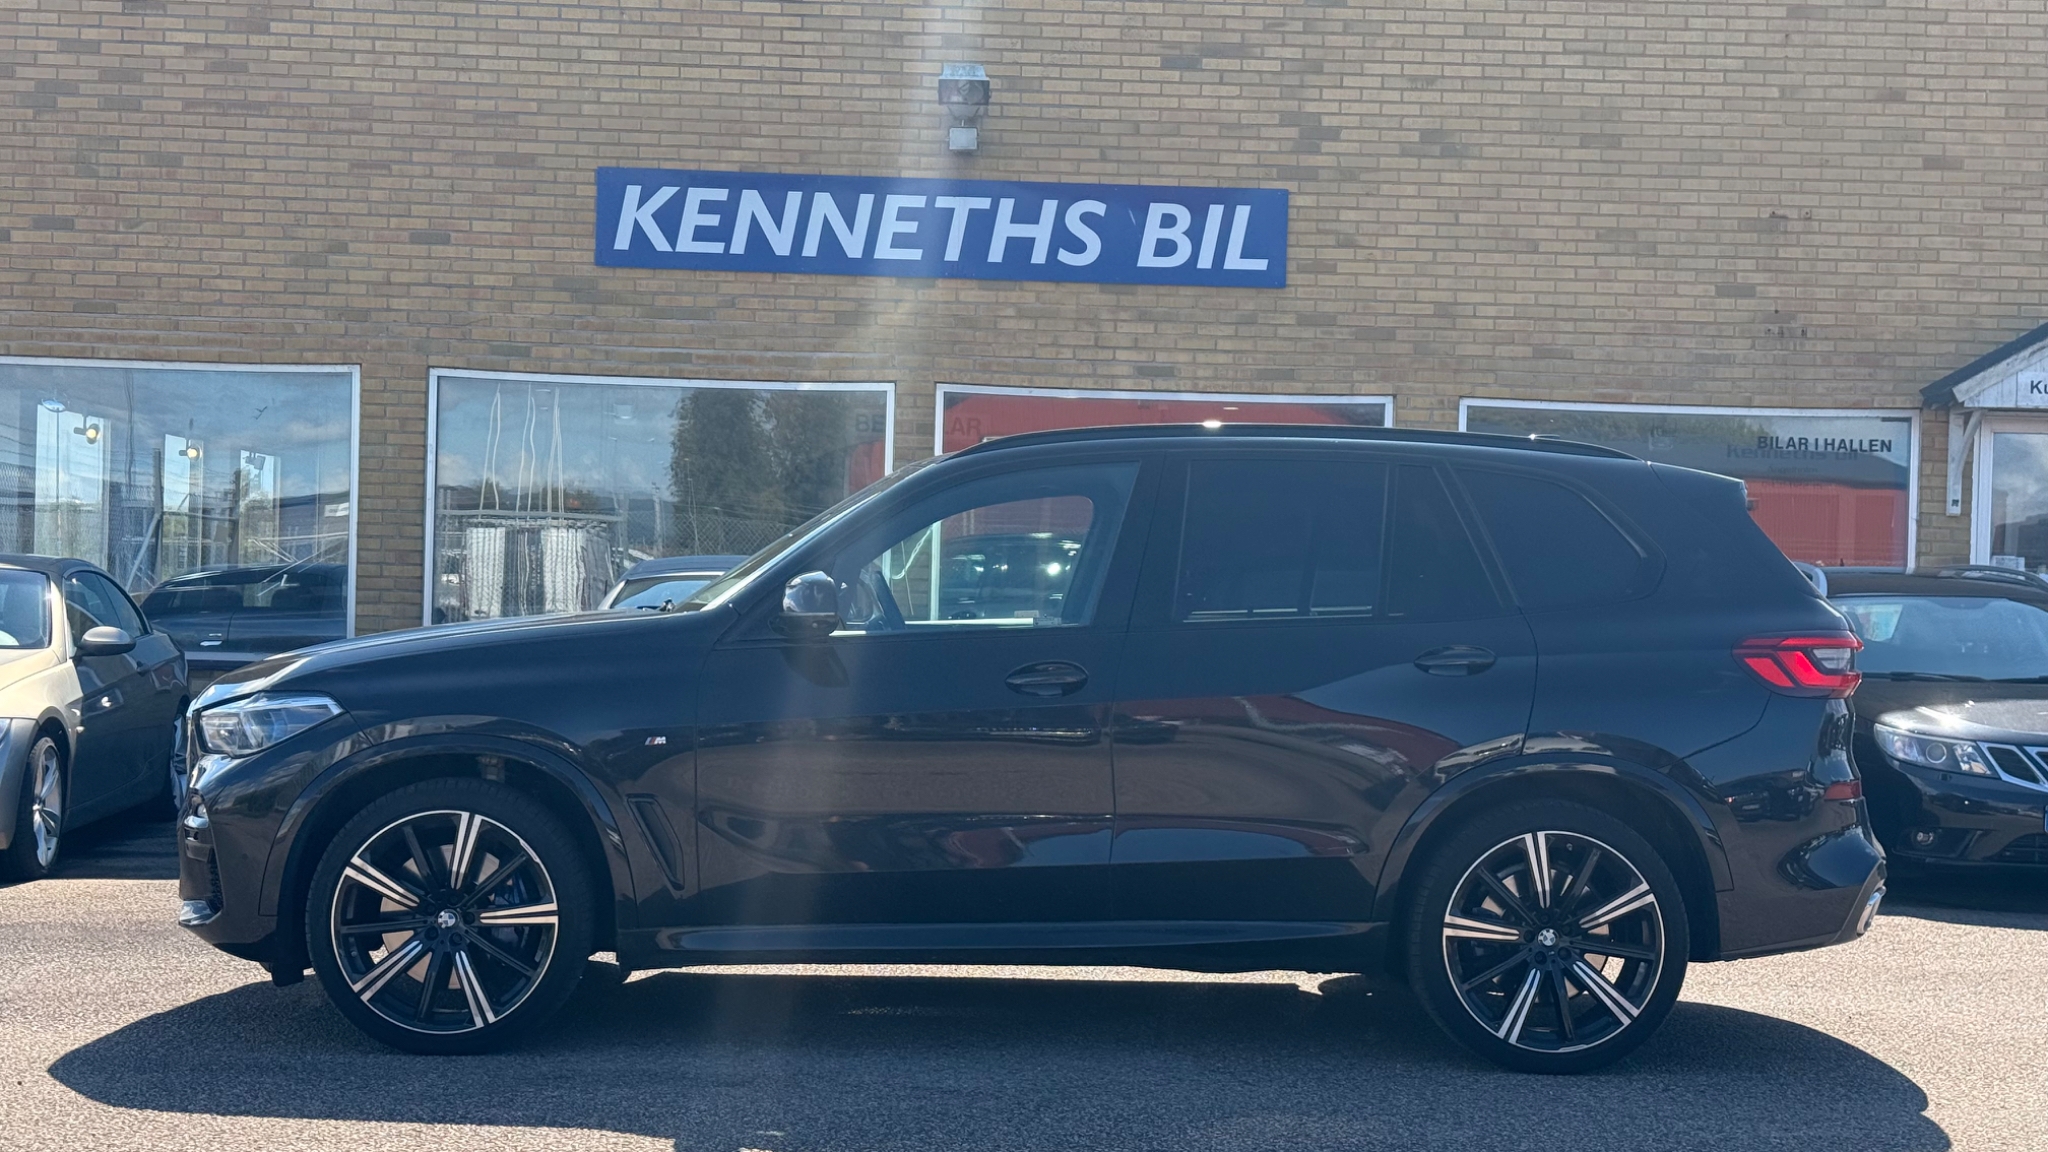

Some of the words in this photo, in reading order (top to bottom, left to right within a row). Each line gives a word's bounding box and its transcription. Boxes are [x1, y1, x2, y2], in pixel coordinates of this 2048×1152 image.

[612, 184, 1106, 267] KENNETHS
[1137, 202, 1269, 271] BIL
[945, 416, 982, 436] AR
[1757, 435, 1809, 451] BILAR
[1814, 437, 1819, 451] I
[1824, 437, 1893, 453] HALLEN
